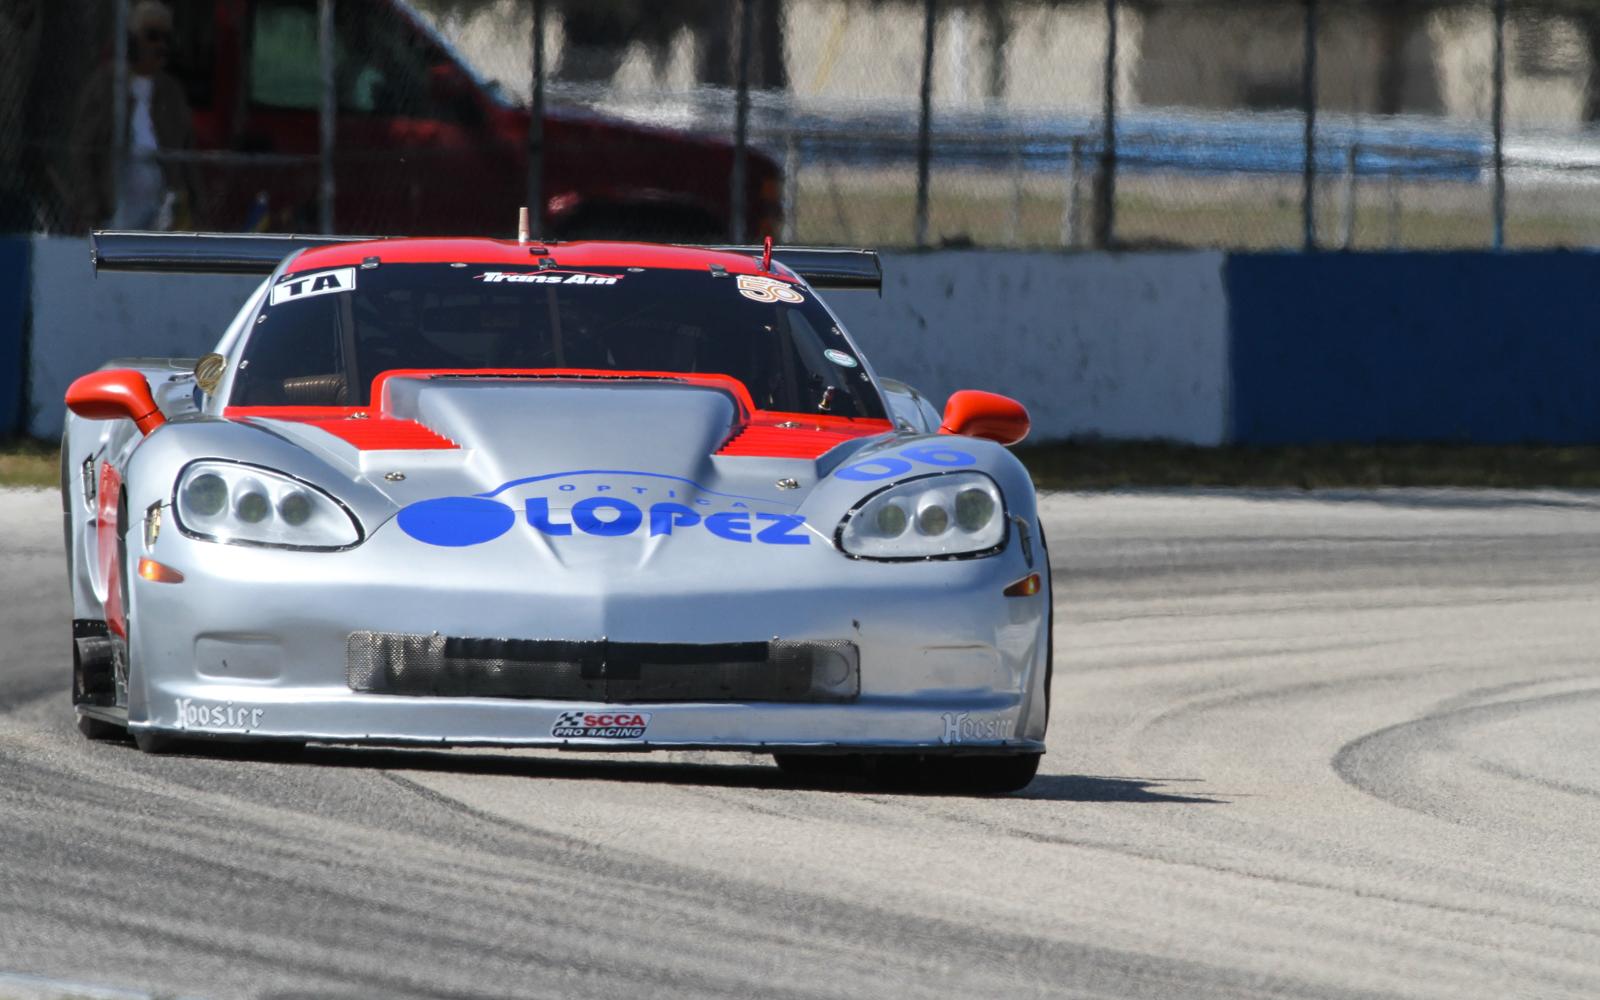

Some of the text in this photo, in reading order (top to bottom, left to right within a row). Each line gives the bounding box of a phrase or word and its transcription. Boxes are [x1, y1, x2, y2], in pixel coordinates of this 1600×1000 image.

[283, 274, 342, 296] TA
[483, 271, 618, 285] Trans Am
[737, 275, 805, 303] 50
[558, 484, 749, 508] OPTICA
[525, 496, 811, 545] LOPEZ
[174, 698, 264, 729] Hoosier
[583, 714, 645, 727] SCCA
[555, 727, 641, 737] PRO RACING
